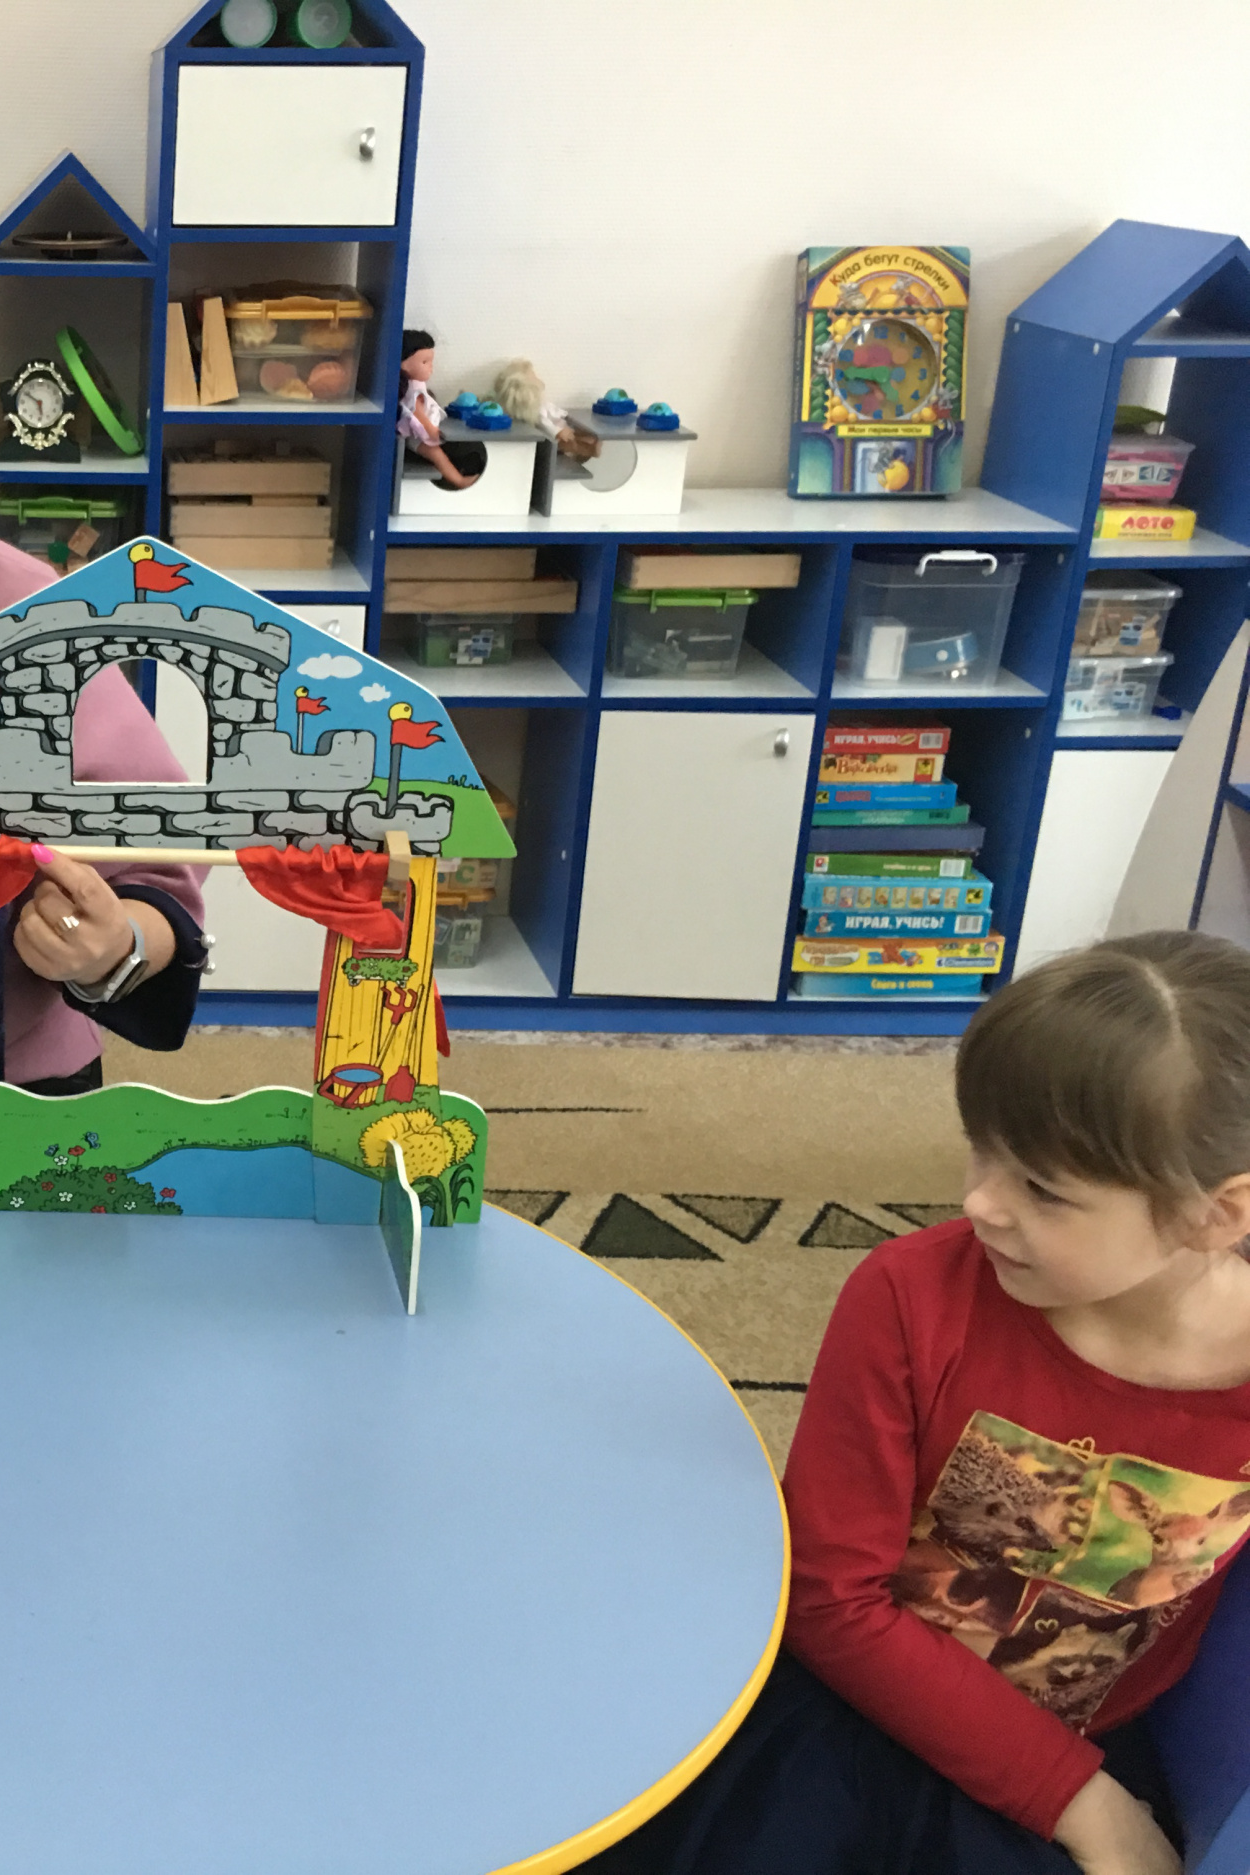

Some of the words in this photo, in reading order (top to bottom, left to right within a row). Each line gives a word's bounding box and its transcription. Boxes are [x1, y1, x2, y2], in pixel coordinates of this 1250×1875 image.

[829, 262, 861, 287] Куда
[864, 253, 900, 266] бегут
[903, 256, 950, 291] стрелки
[1121, 516, 1174, 530] ЛОТО
[894, 916, 945, 929] УЧИСЬ!
